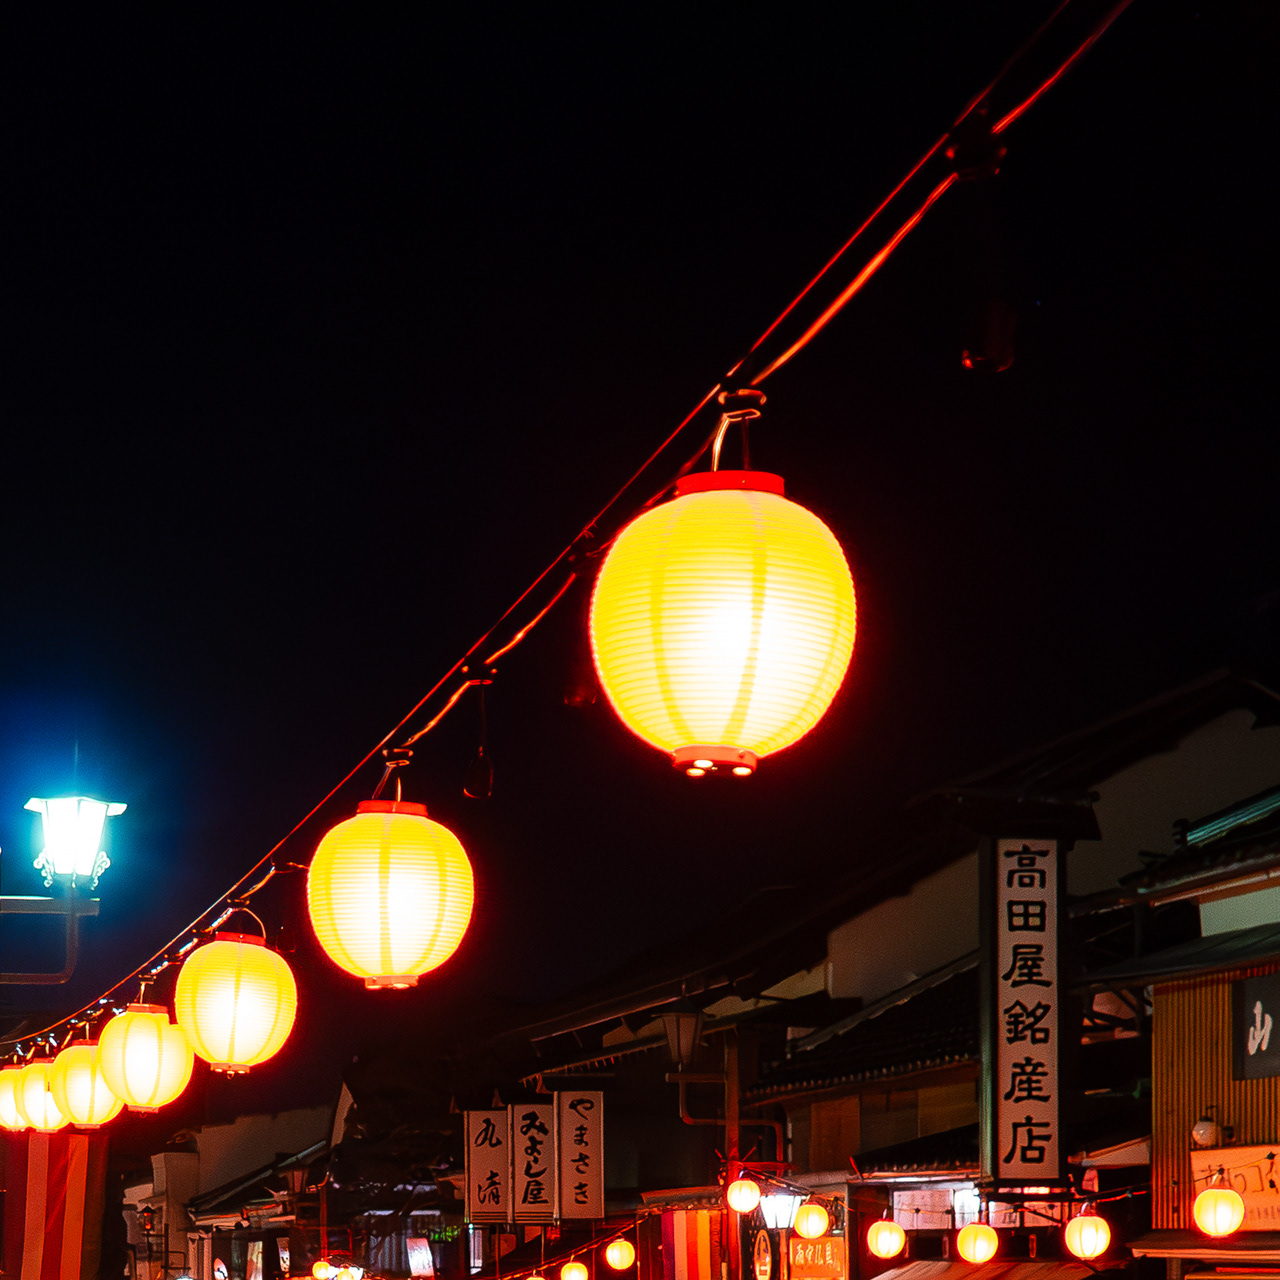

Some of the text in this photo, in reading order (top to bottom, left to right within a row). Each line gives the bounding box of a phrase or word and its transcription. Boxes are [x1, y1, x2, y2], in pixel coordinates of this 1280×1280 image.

[1001, 845, 1053, 1165] 高田屋銘産店
[520, 1111, 549, 1205] みよし屋
[568, 1098, 595, 1205] やまさき
